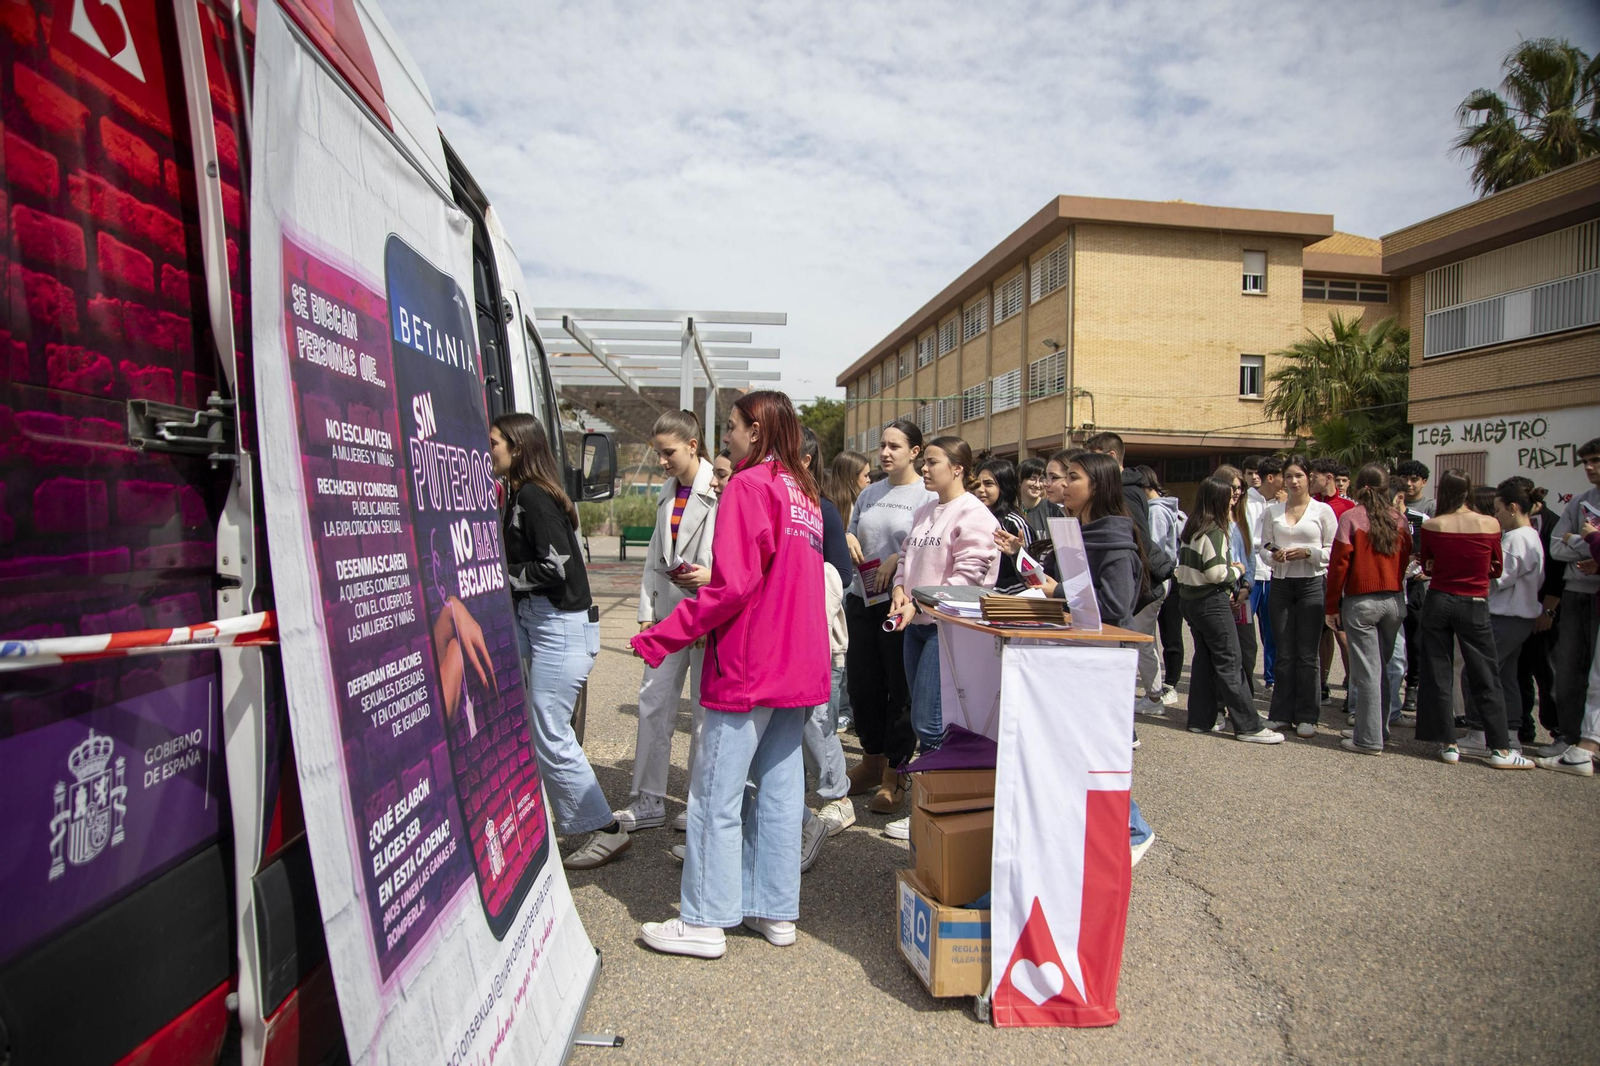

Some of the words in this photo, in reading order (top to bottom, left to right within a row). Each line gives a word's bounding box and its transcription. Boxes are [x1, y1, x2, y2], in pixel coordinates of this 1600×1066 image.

[291, 283, 309, 320] SE
[311, 293, 358, 341] BUSCAN
[297, 326, 357, 377] PERSONAS
[399, 306, 476, 375] BETANIA
[326, 418, 341, 440] NO
[342, 422, 392, 450] ESCLAVICEN
[412, 392, 437, 440] SIN
[339, 445, 370, 464] MUJERES
[377, 448, 395, 468] NIÑAS
[409, 438, 497, 511] PUTEROS
[1518, 443, 1583, 469] PADIL
[317, 478, 357, 495] RECHACEN
[364, 482, 398, 498] CONDENEN
[353, 496, 400, 515] PÚBLICAMENTE
[787, 486, 806, 508] NO
[886, 503, 913, 512] PROMESAS
[324, 521, 336, 537] LA
[337, 517, 380, 536] EXPLOTACIÓN
[382, 520, 403, 535] SEXUAL
[450, 518, 472, 566] NO
[472, 521, 499, 561] HAY
[336, 553, 408, 581] DESENMASCAREN
[458, 563, 504, 599] ESCLAVAS
[346, 581, 374, 603] QUIENES
[374, 574, 411, 596] COMERCIAN
[355, 602, 370, 619] CON
[370, 600, 379, 616] EL
[379, 593, 404, 614] CUERPO
[404, 591, 413, 605] DE
[348, 625, 361, 643] LAS
[361, 615, 394, 640] MUJERES
[398, 606, 415, 627] NIÑAS
[347, 667, 386, 698] DEFIENDAN
[386, 650, 422, 682] RELACIONES
[360, 683, 395, 714] SEXUALES
[395, 668, 425, 696] DESEADAS
[378, 708, 388, 725] EN
[388, 686, 428, 722] CONDICIONES
[392, 720, 402, 738] DE
[402, 703, 430, 733] IGUALDAD
[144, 728, 202, 765] GOBIERNO
[144, 768, 160, 788] DE
[163, 748, 201, 778] ESPAÑA
[369, 804, 394, 851] ¿QUÉ
[395, 778, 430, 820] ESLABÓN
[372, 837, 406, 878] ELIGES
[406, 817, 421, 847] SER
[378, 879, 393, 908] EN
[394, 860, 416, 893] ESTA
[415, 819, 450, 867] CADENA?
[401, 885, 418, 912] UNEN
[418, 870, 430, 891] LAS
[429, 847, 450, 875] GANAS
[387, 896, 426, 951] ROMPERLA!
[952, 945, 979, 953] REGLA
[446, 873, 553, 1066] cionsexual@nuevohogarbetania.com
